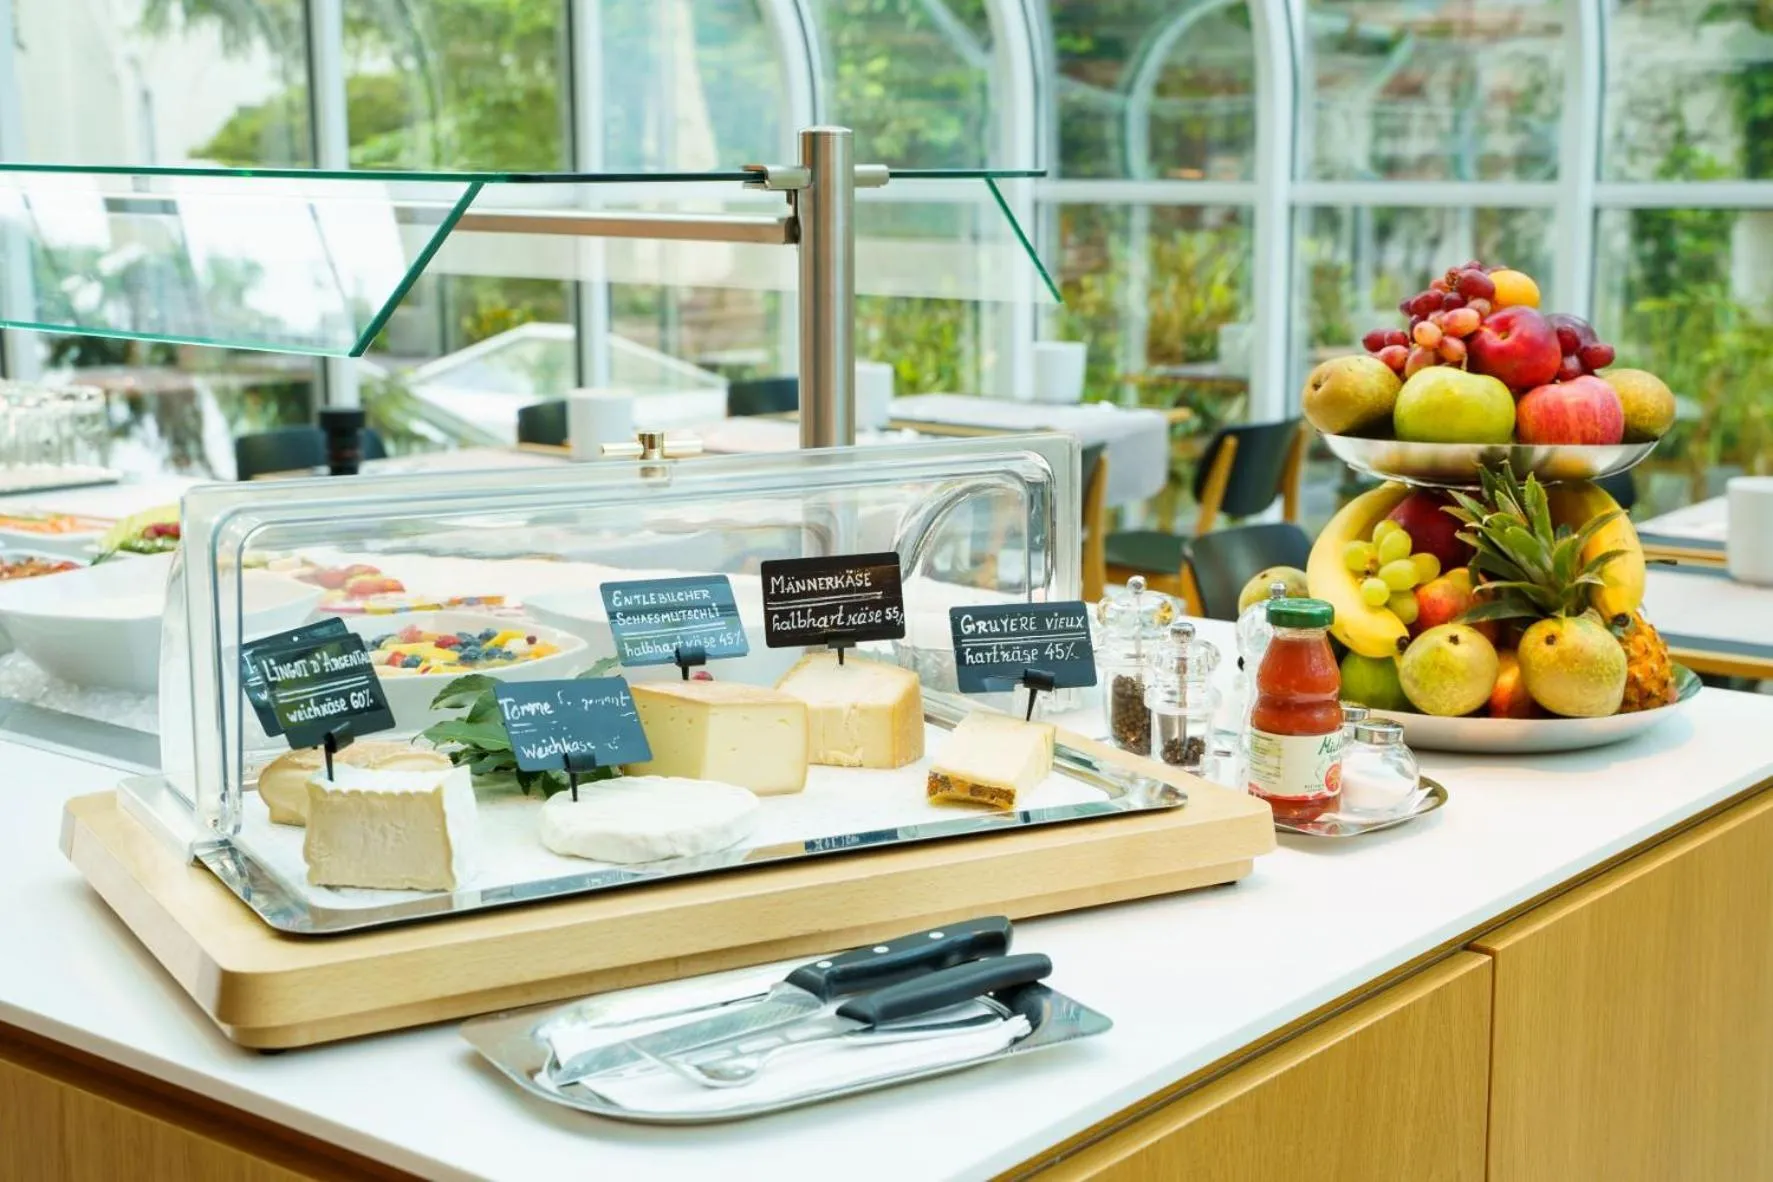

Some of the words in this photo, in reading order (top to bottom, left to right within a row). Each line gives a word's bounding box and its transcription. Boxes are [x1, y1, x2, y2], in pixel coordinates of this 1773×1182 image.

[769, 569, 873, 594] MÄNNERKÄSE
[1044, 642, 1077, 662] 45%
[350, 688, 374, 709] 60%
[497, 697, 554, 720] Tomme
